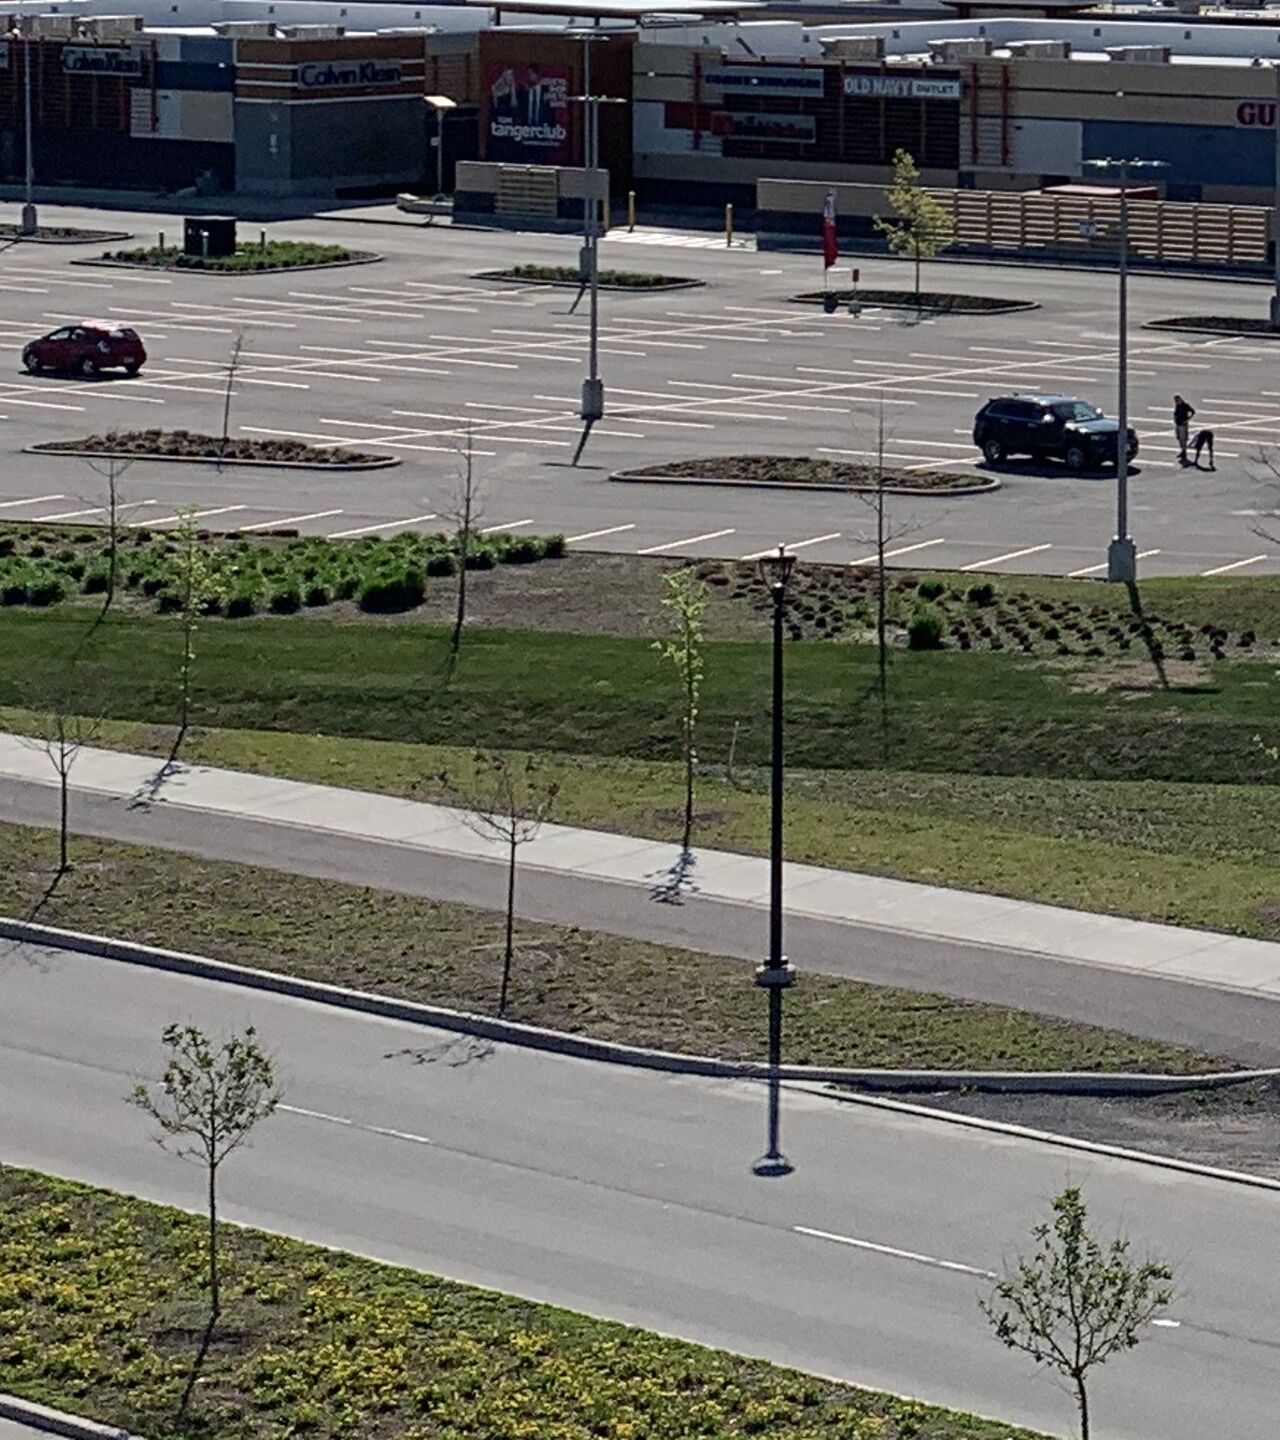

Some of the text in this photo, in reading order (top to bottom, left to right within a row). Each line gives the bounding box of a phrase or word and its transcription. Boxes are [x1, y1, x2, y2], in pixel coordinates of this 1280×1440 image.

[302, 62, 400, 86] Calvin Klein
[844, 77, 955, 96] OLD NAVY OUTLET
[490, 121, 567, 141] tangerclub
